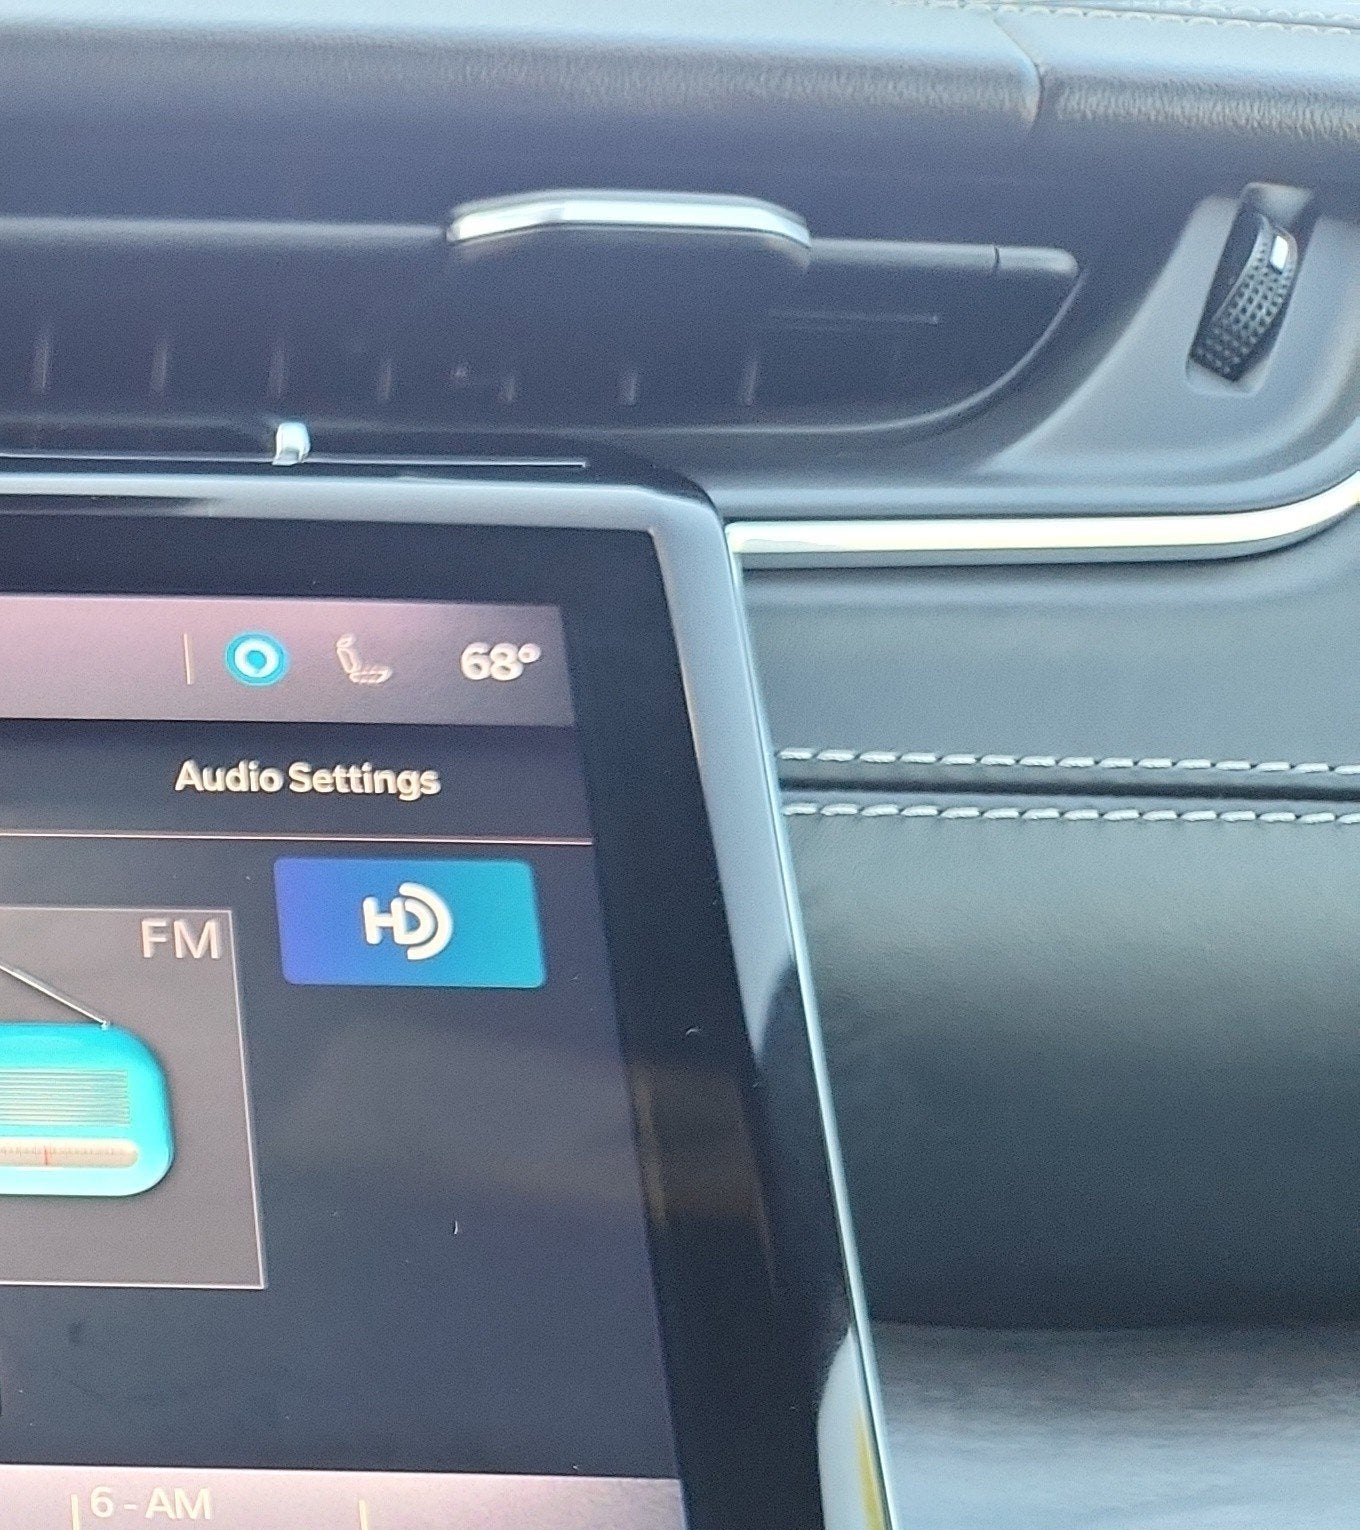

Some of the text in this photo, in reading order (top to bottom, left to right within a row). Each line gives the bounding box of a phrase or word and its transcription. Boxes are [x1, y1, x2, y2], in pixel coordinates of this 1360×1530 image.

[174, 759, 442, 801] Audio Settings
[141, 918, 222, 959] FM
[91, 1486, 115, 1518] 6
[144, 1487, 213, 1520] AM
